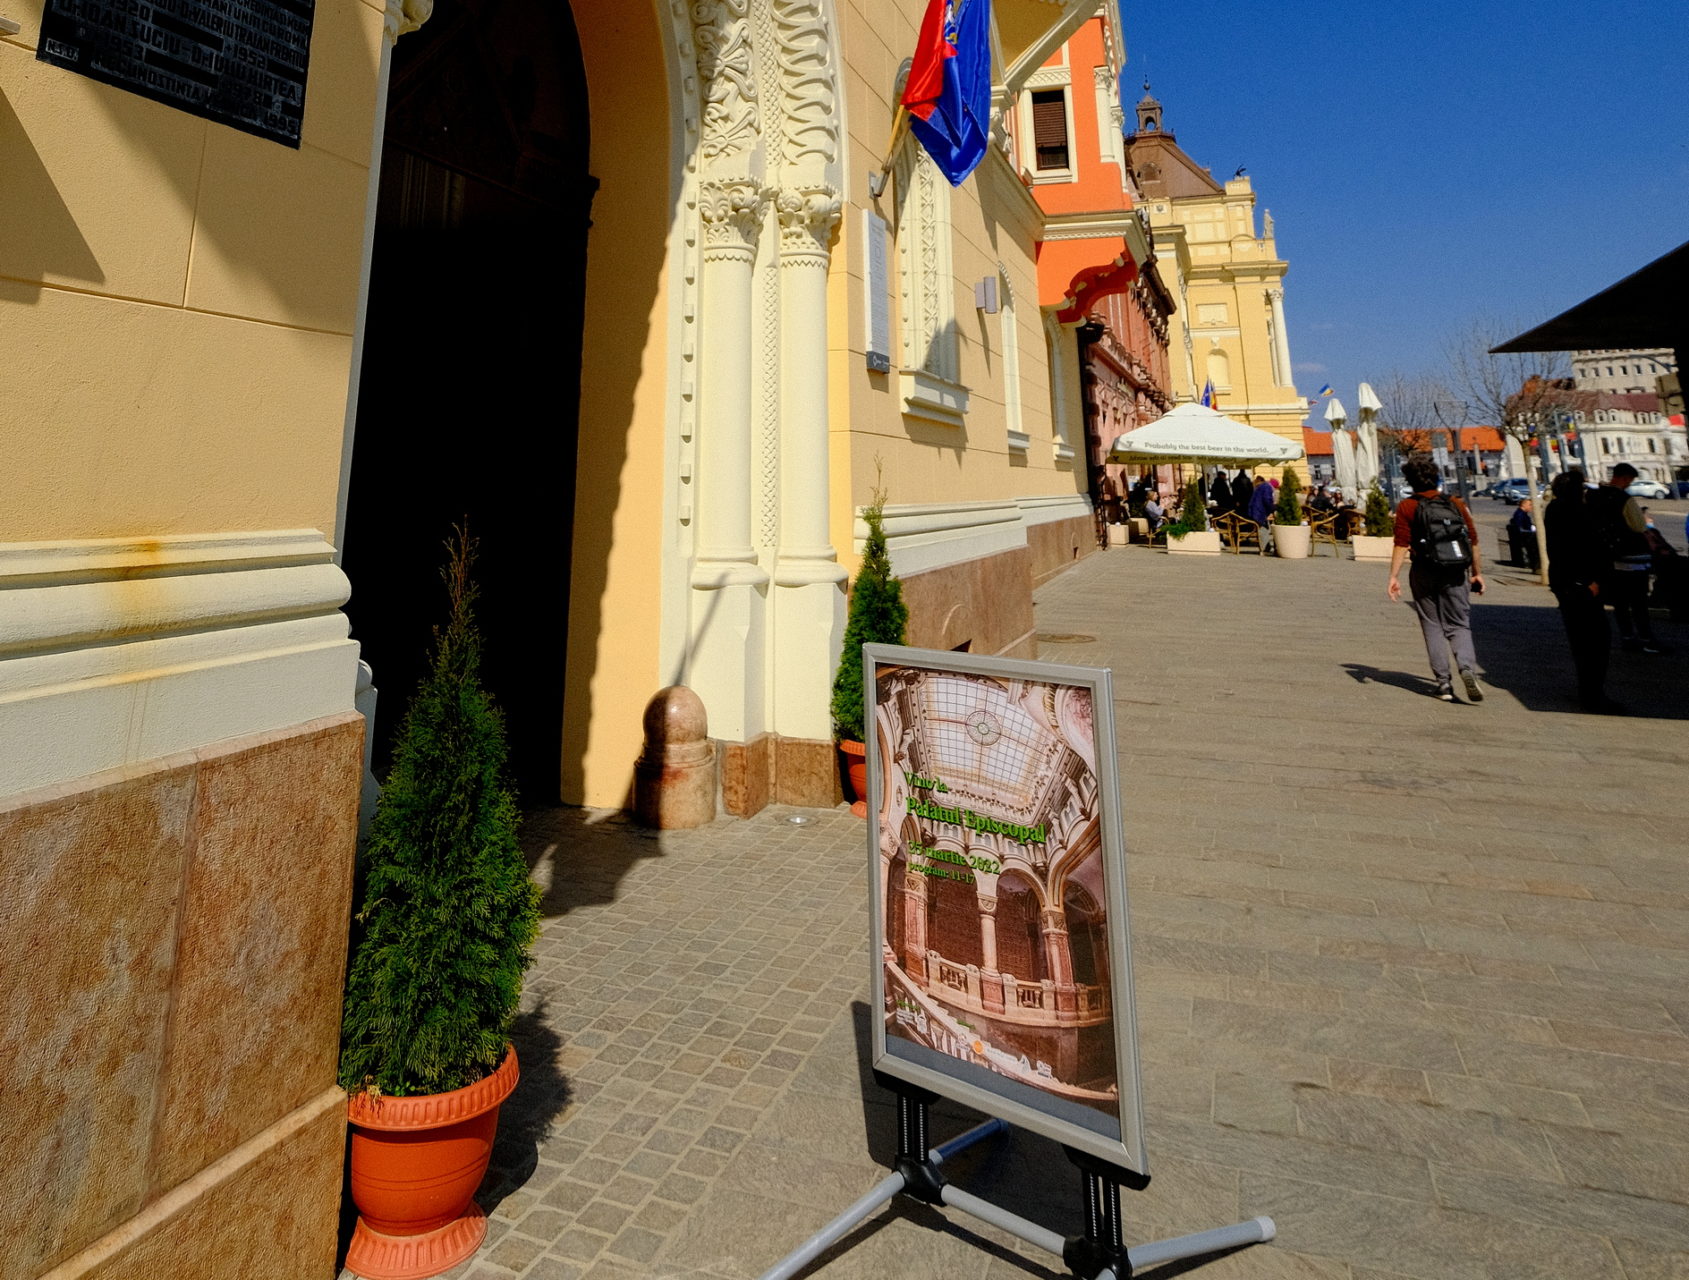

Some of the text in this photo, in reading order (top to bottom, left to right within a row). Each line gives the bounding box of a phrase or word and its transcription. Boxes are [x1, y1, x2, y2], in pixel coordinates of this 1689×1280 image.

[129, 19, 180, 55] SUCIU
[208, 51, 246, 81] IULIU
[248, 68, 296, 101] HIRTEA
[1144, 441, 1270, 454] Probably the best beer in the world.
[904, 771, 949, 794] Vino la
[905, 796, 1046, 846] Palatul Episcopal
[908, 862, 949, 879] program:
[925, 847, 967, 866] martie
[969, 855, 1001, 876] 2022
